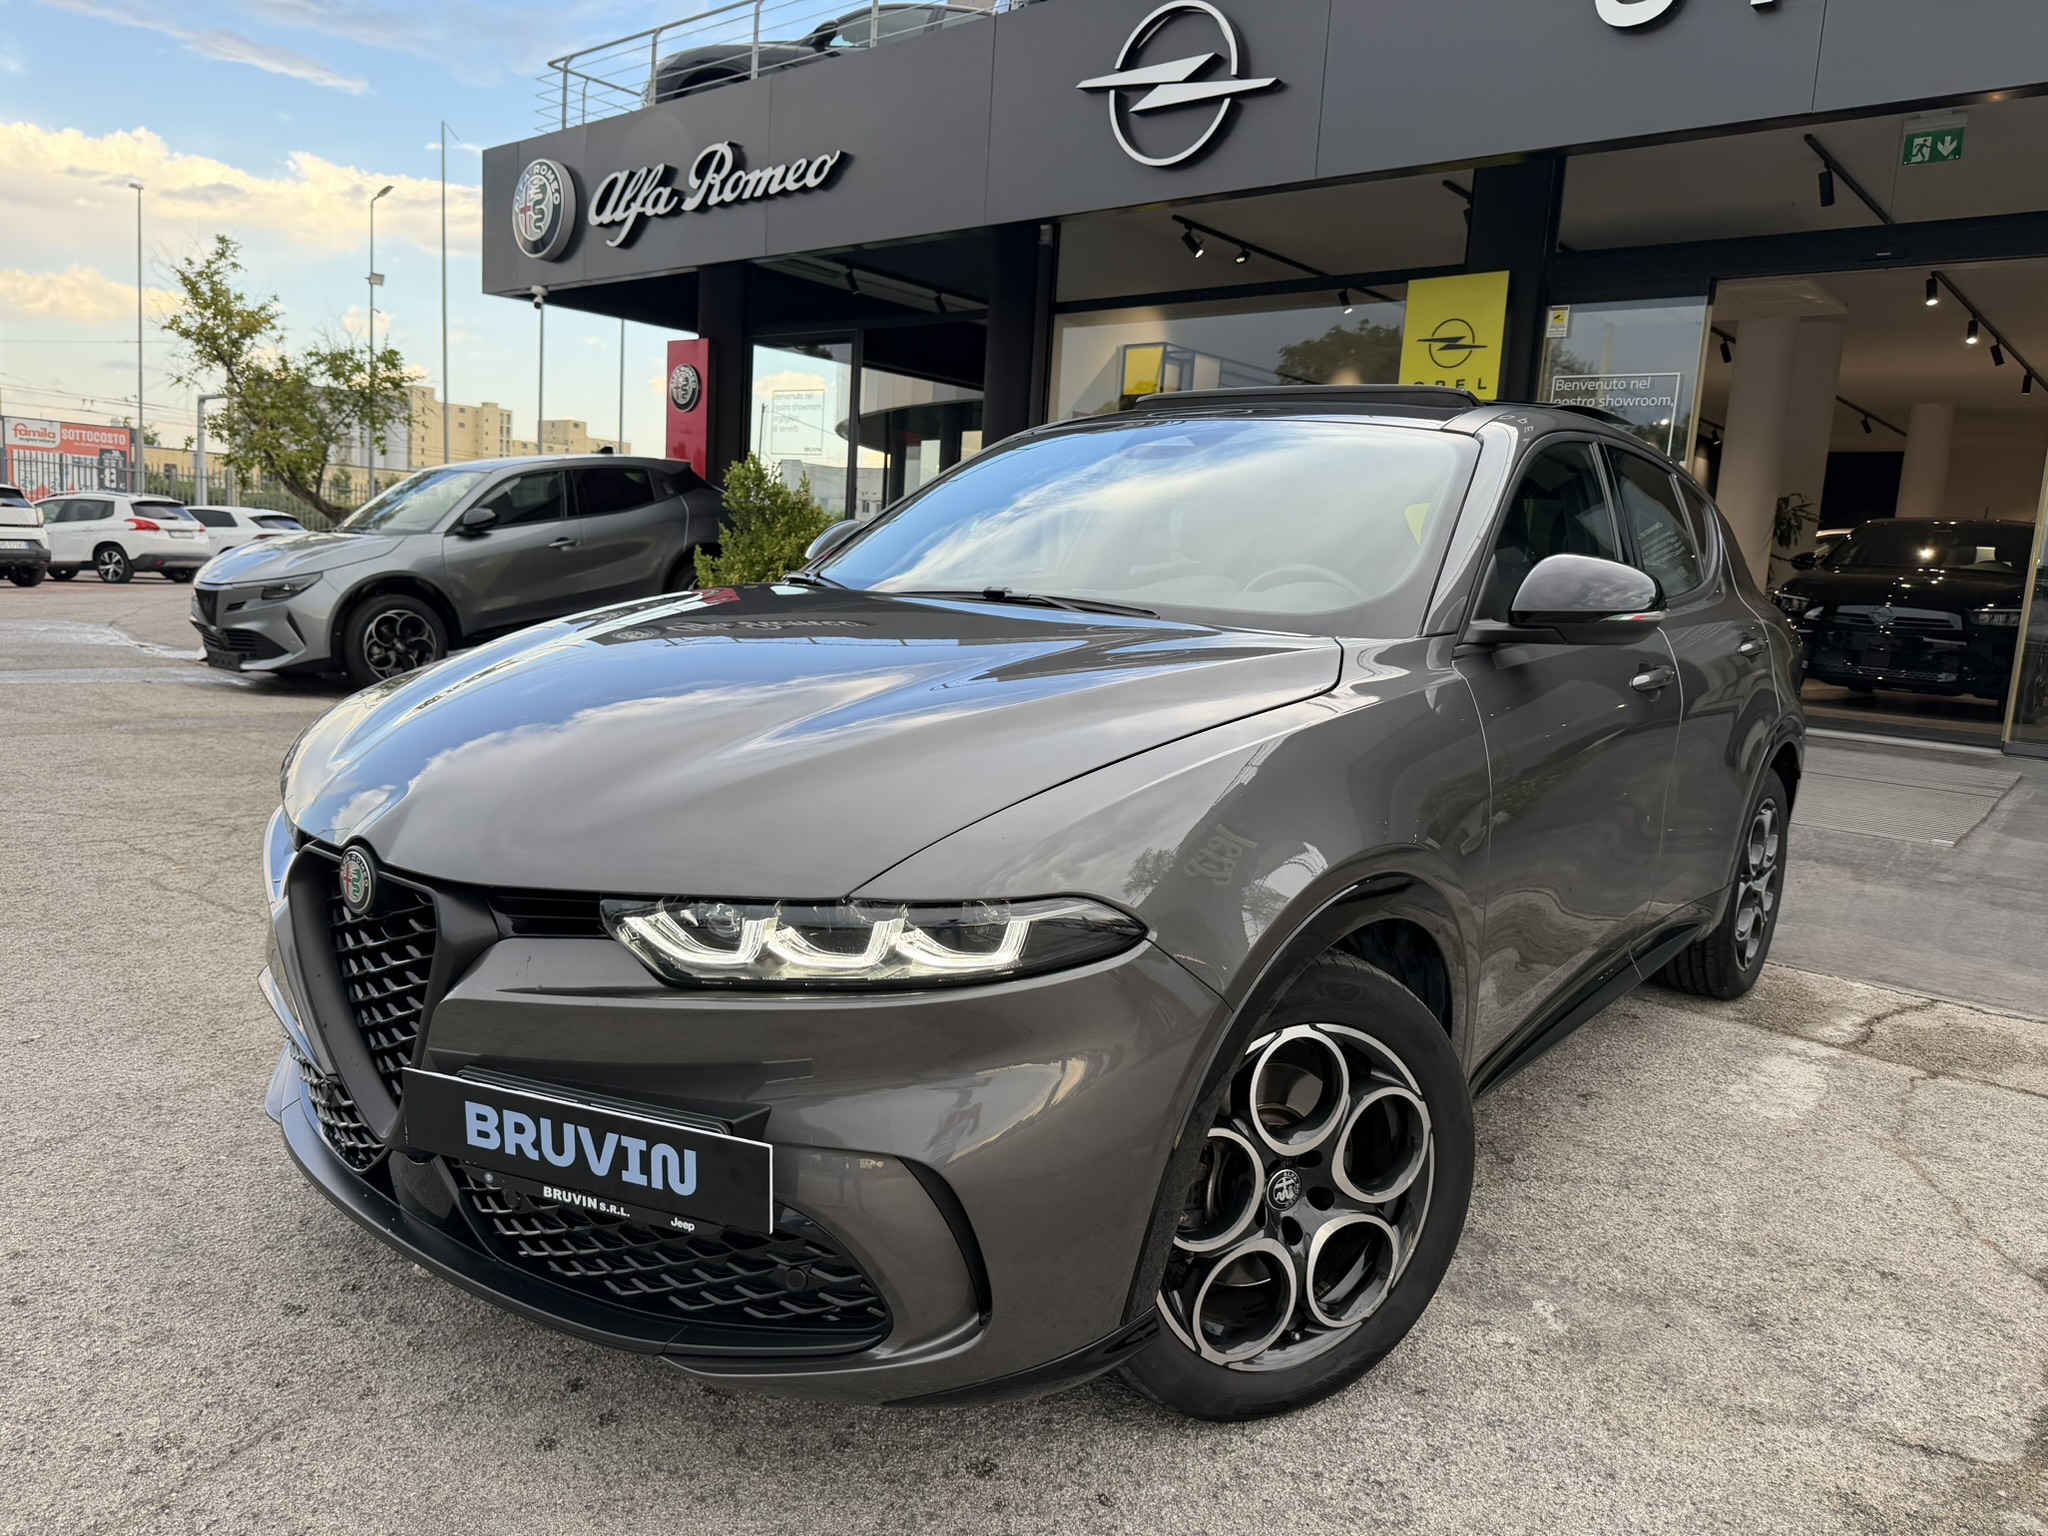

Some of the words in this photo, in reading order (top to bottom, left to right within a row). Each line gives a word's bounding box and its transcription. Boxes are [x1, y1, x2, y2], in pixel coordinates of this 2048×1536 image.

[533, 164, 561, 205] ROMEO
[588, 163, 678, 247] Alfa
[681, 141, 841, 212] Romeo
[1555, 378, 1627, 391] Benvenuto
[1630, 376, 1651, 389] nel
[1553, 396, 1596, 407] nostro
[1599, 395, 1674, 407] showroom,
[12, 423, 56, 439] famila
[61, 428, 126, 445] SOTTOCOSTO
[464, 1100, 697, 1196] BRUVIN
[543, 1186, 598, 1210] BRUVIN
[599, 1202, 631, 1217] S.R.L.
[670, 1217, 696, 1232] Jeep
